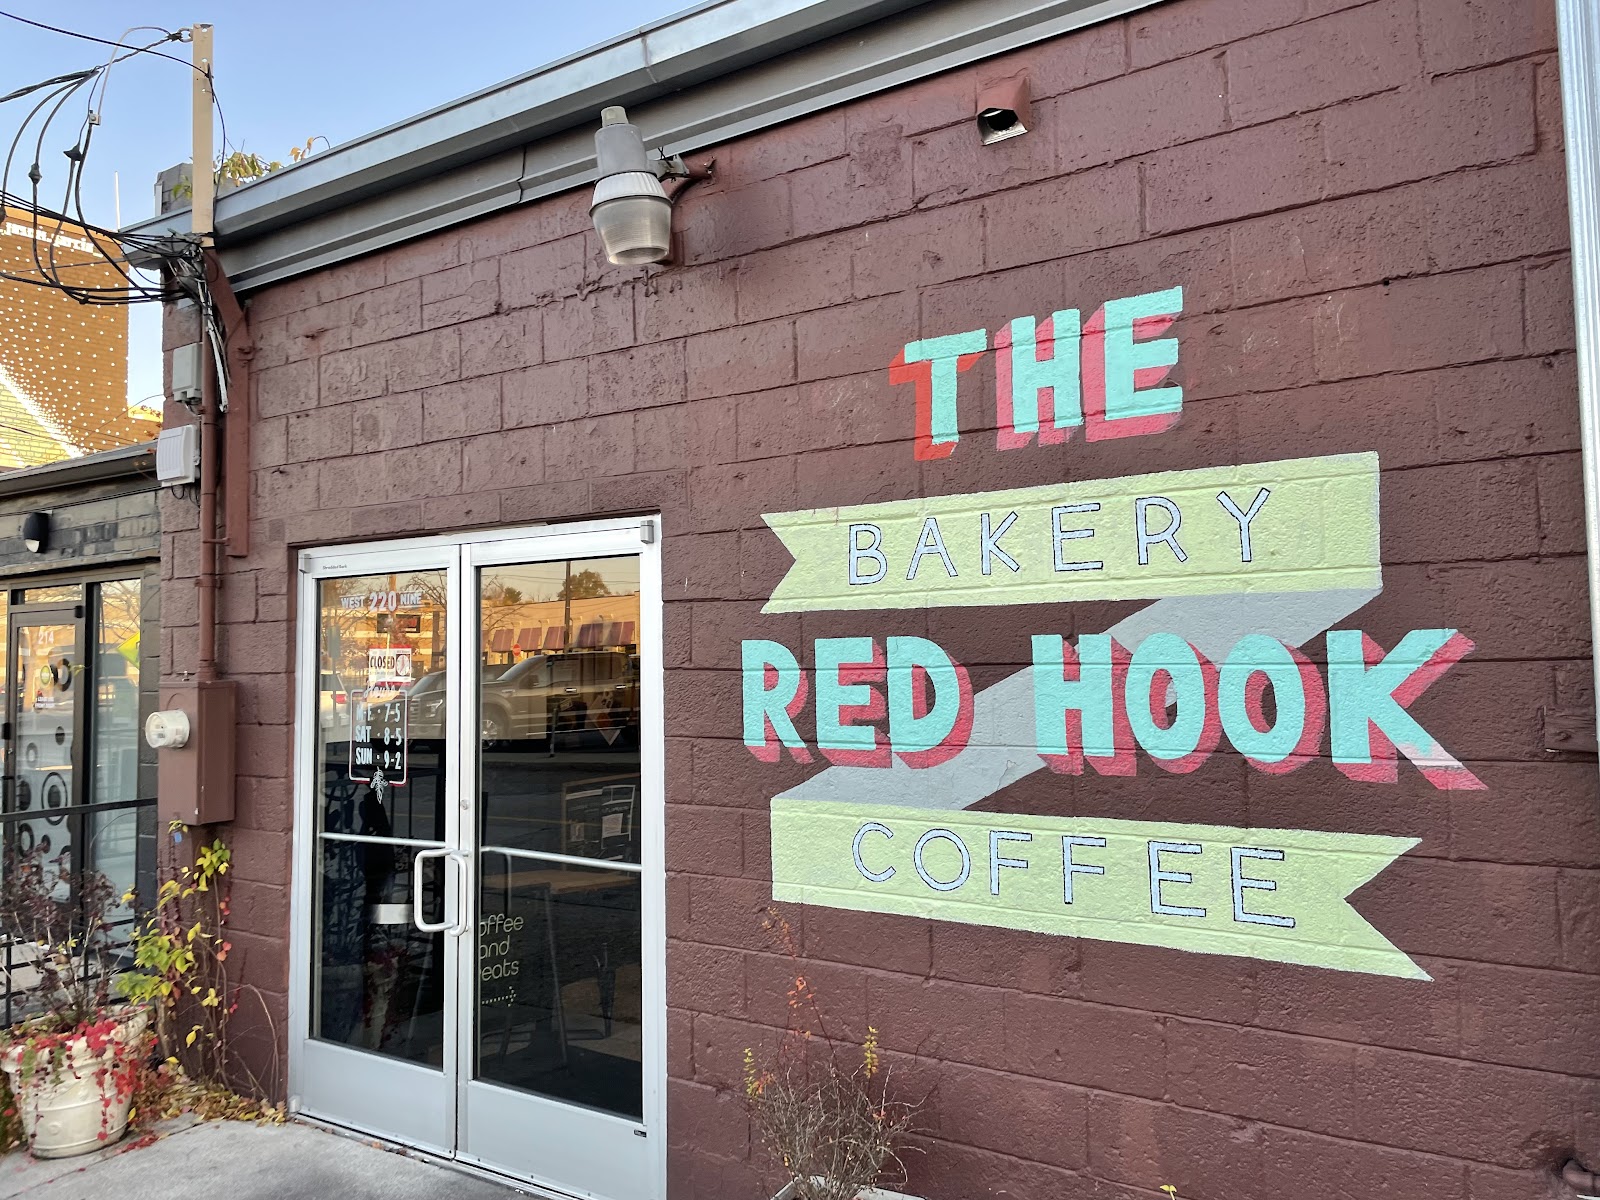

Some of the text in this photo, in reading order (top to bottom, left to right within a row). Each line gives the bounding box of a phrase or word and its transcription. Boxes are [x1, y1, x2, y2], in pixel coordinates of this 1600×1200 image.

[889, 285, 1184, 460] THE
[848, 487, 1271, 587] BAKERY
[340, 590, 422, 612] WEST 220 NINE
[38, 630, 55, 645] 214
[370, 655, 396, 670] CLOSED
[384, 703, 401, 722] 7-5
[741, 628, 1484, 789] RED HOOK
[355, 725, 402, 746] SAT 8-5
[355, 746, 402, 769] SUN 9-2
[852, 822, 1296, 928] COFFEE
[480, 913, 524, 937] offee
[480, 934, 510, 959] and
[480, 958, 519, 981] eats
